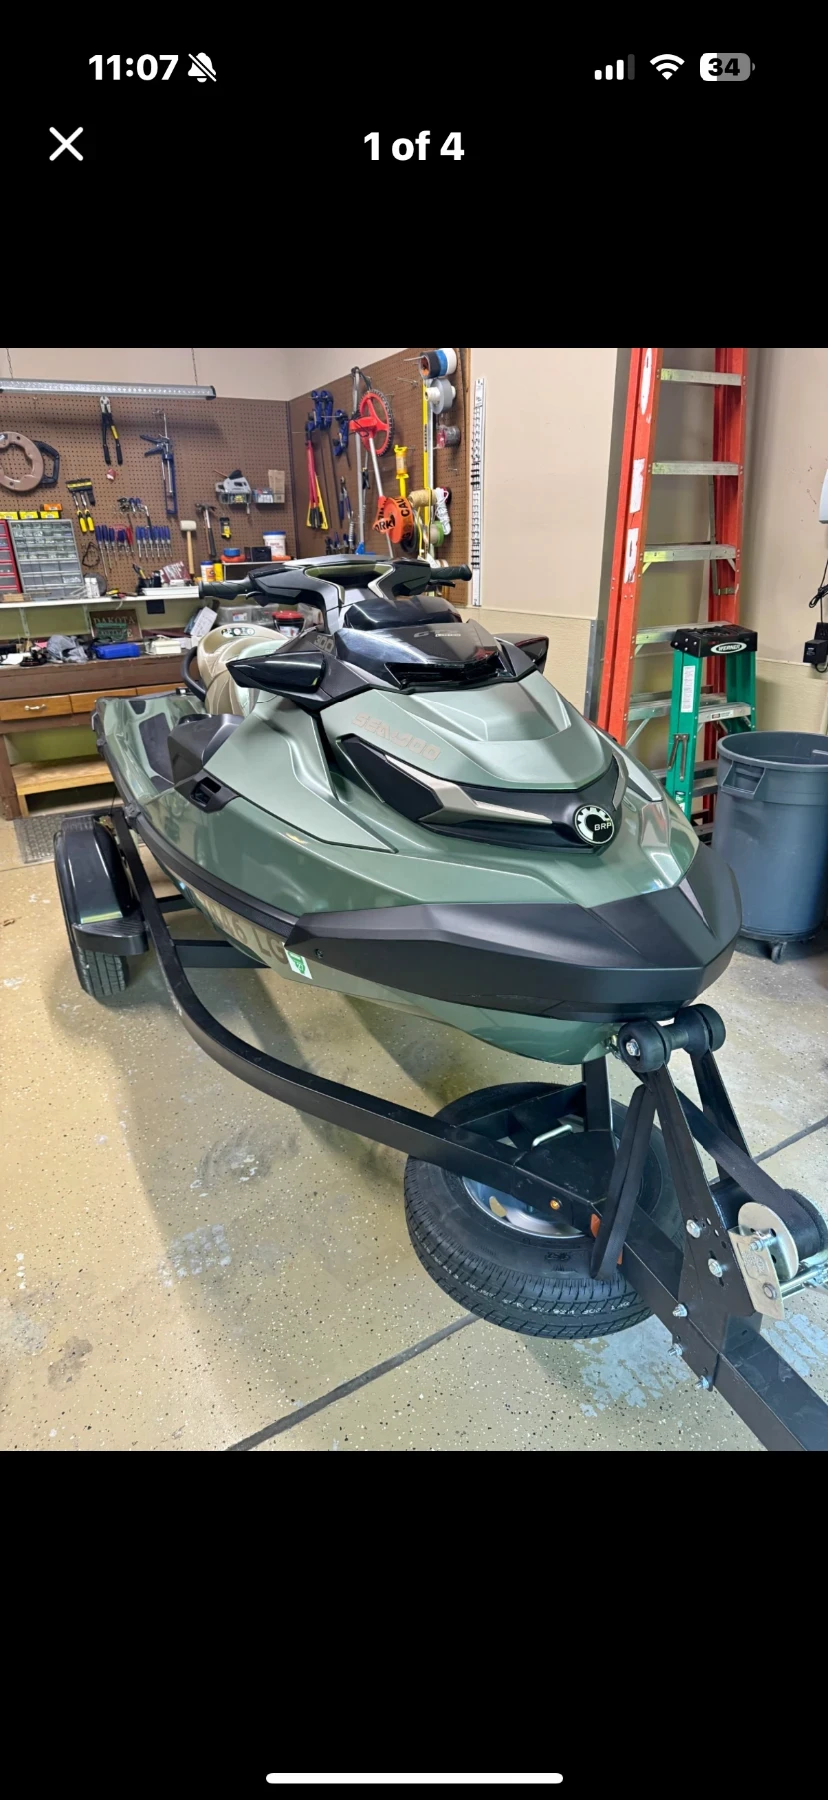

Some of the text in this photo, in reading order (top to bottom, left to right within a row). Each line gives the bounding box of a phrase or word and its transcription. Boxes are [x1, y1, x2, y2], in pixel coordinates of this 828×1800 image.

[313, 634, 335, 653] 300
[718, 643, 741, 652] WERNER
[594, 822, 612, 831] BRP
[251, 927, 288, 966] LG
